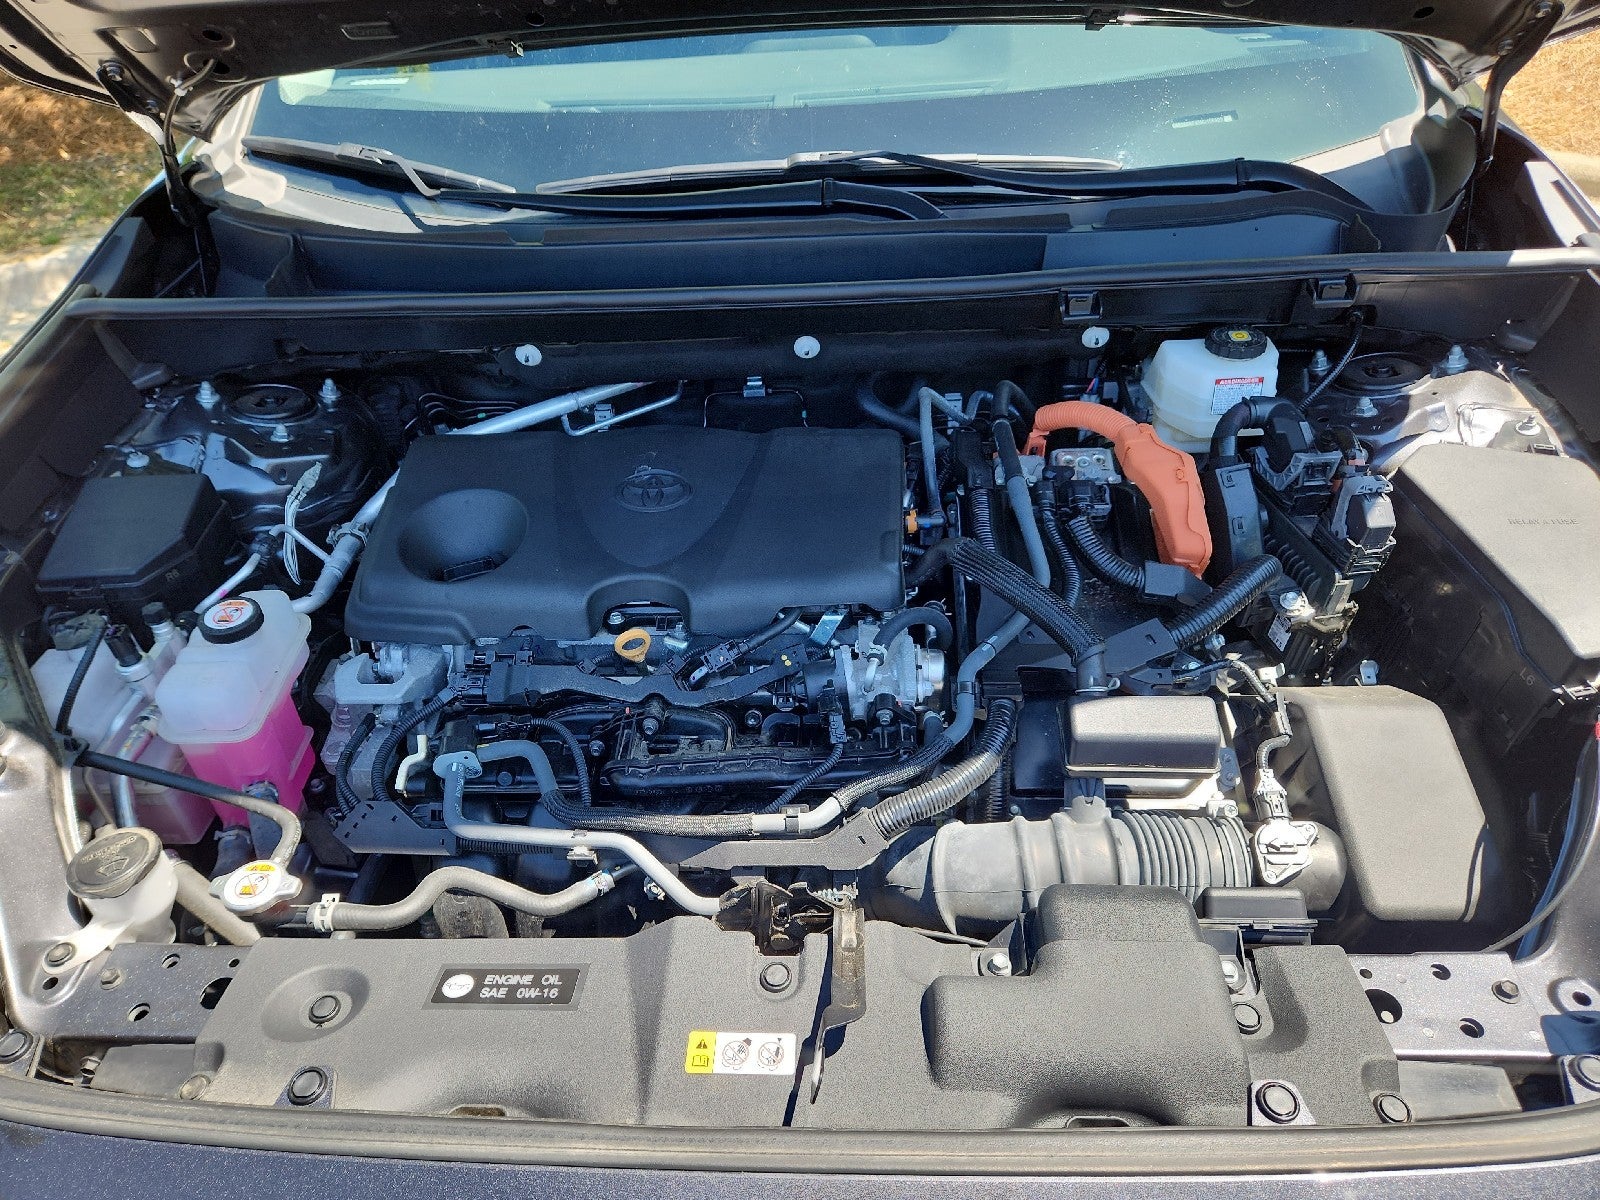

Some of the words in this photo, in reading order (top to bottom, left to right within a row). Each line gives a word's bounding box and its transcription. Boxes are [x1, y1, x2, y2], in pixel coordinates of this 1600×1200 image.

[484, 974, 534, 985] ENGINE
[541, 974, 562, 985] OIL
[479, 987, 508, 998] SAE
[516, 987, 558, 998] 0W-16
